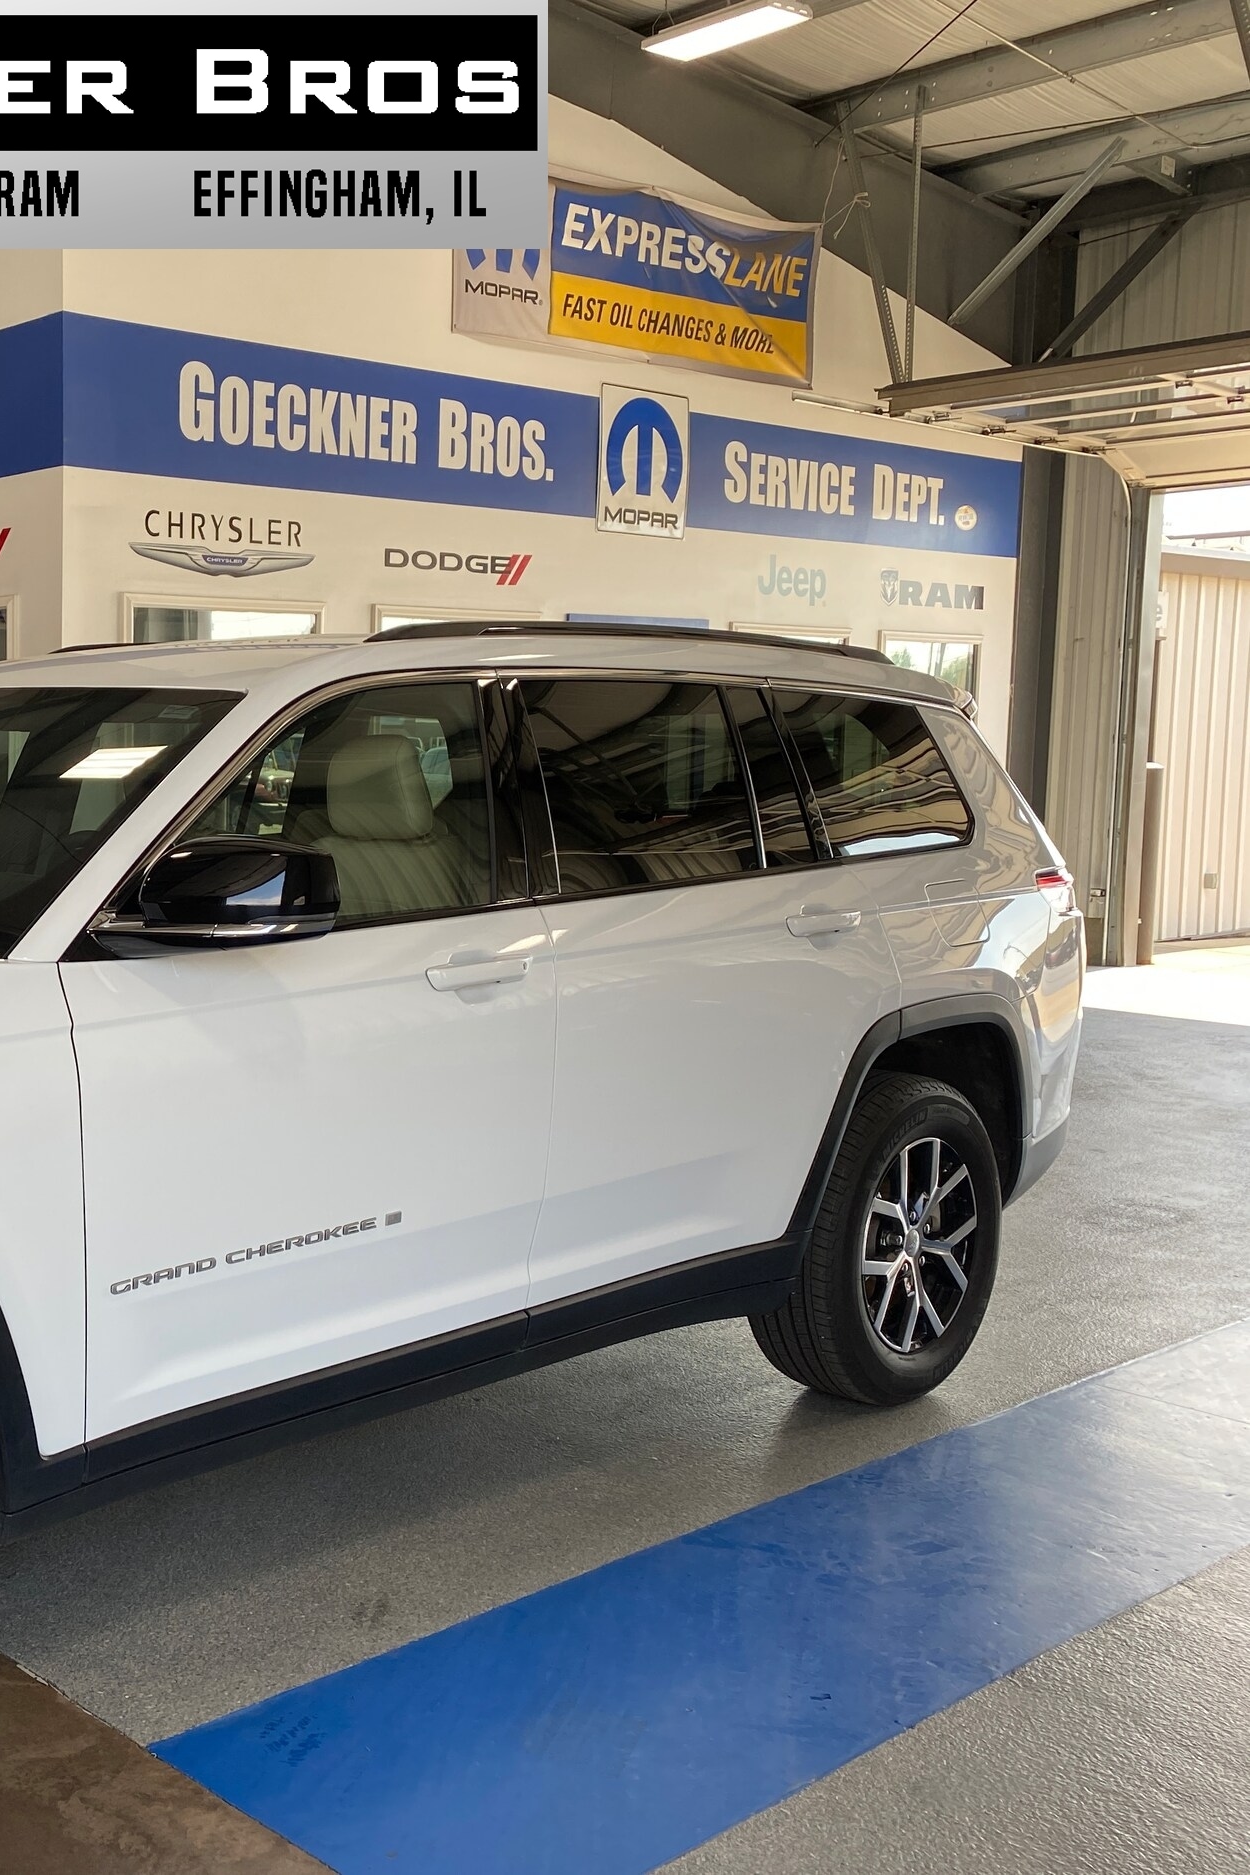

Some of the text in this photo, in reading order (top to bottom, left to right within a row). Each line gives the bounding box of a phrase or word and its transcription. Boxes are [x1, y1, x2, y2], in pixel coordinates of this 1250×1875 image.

[465, 279, 539, 305] MOPAR
[562, 293, 607, 323] FAST
[609, 303, 635, 330] OIL
[638, 309, 714, 343] CHANGES
[714, 323, 726, 346] &
[179, 360, 555, 482] GOECKNER BROS.
[723, 440, 945, 526] SERVICE DEPT.
[144, 509, 302, 548] CHRYSLER
[604, 505, 679, 530] MOPAR
[206, 556, 243, 564] CHRYSLER
[384, 548, 512, 575] DODGE
[757, 554, 827, 607] Jeep
[899, 578, 985, 611] RAM
[110, 1217, 377, 1295] GRAND CHEROKEE
